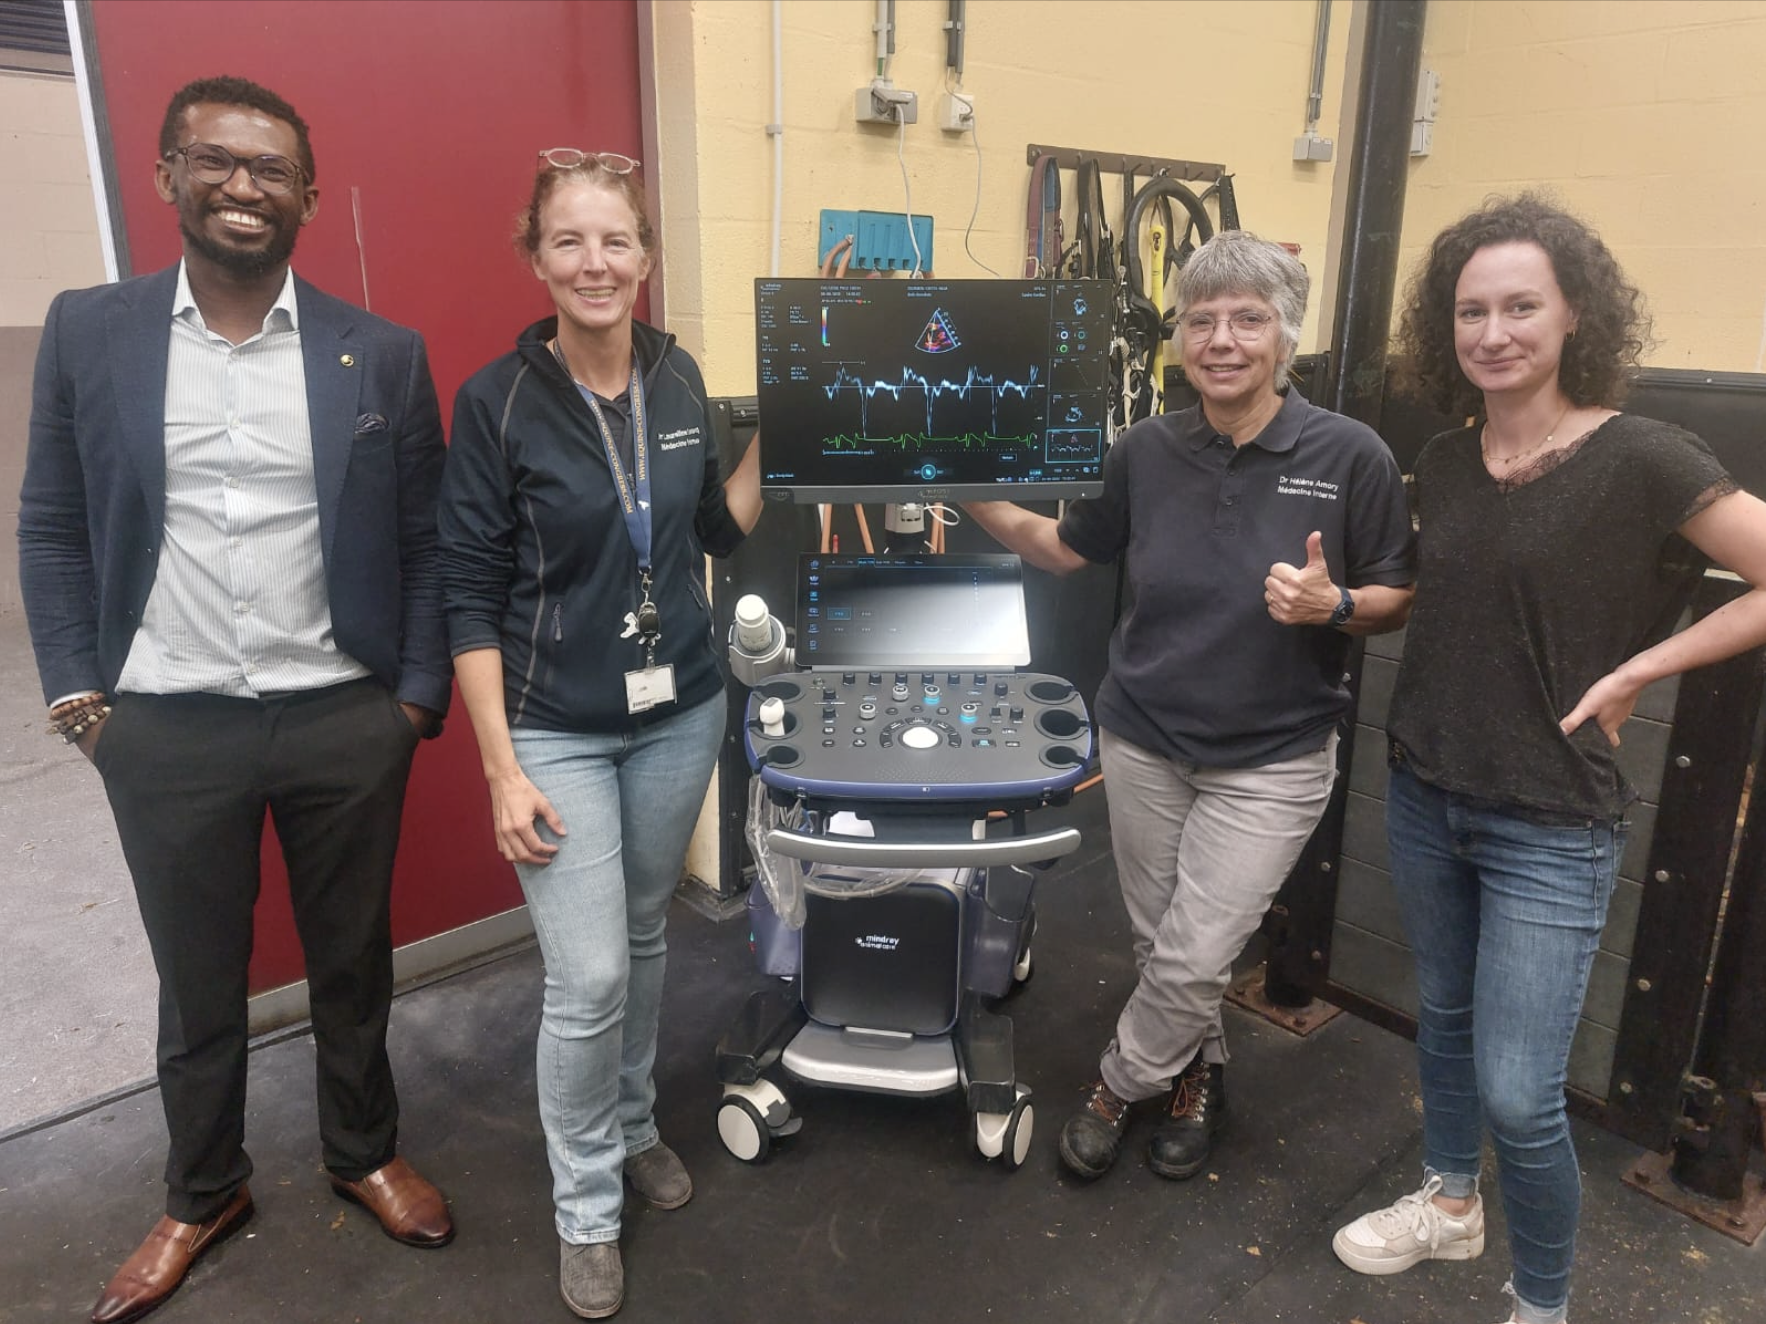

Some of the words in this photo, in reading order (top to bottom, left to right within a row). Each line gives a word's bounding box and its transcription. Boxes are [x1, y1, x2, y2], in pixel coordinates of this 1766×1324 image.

[1279, 475, 1288, 484] Dr
[1315, 480, 1339, 492] Amory
[1313, 489, 1337, 500] Interne
[866, 934, 900, 946] mindray
